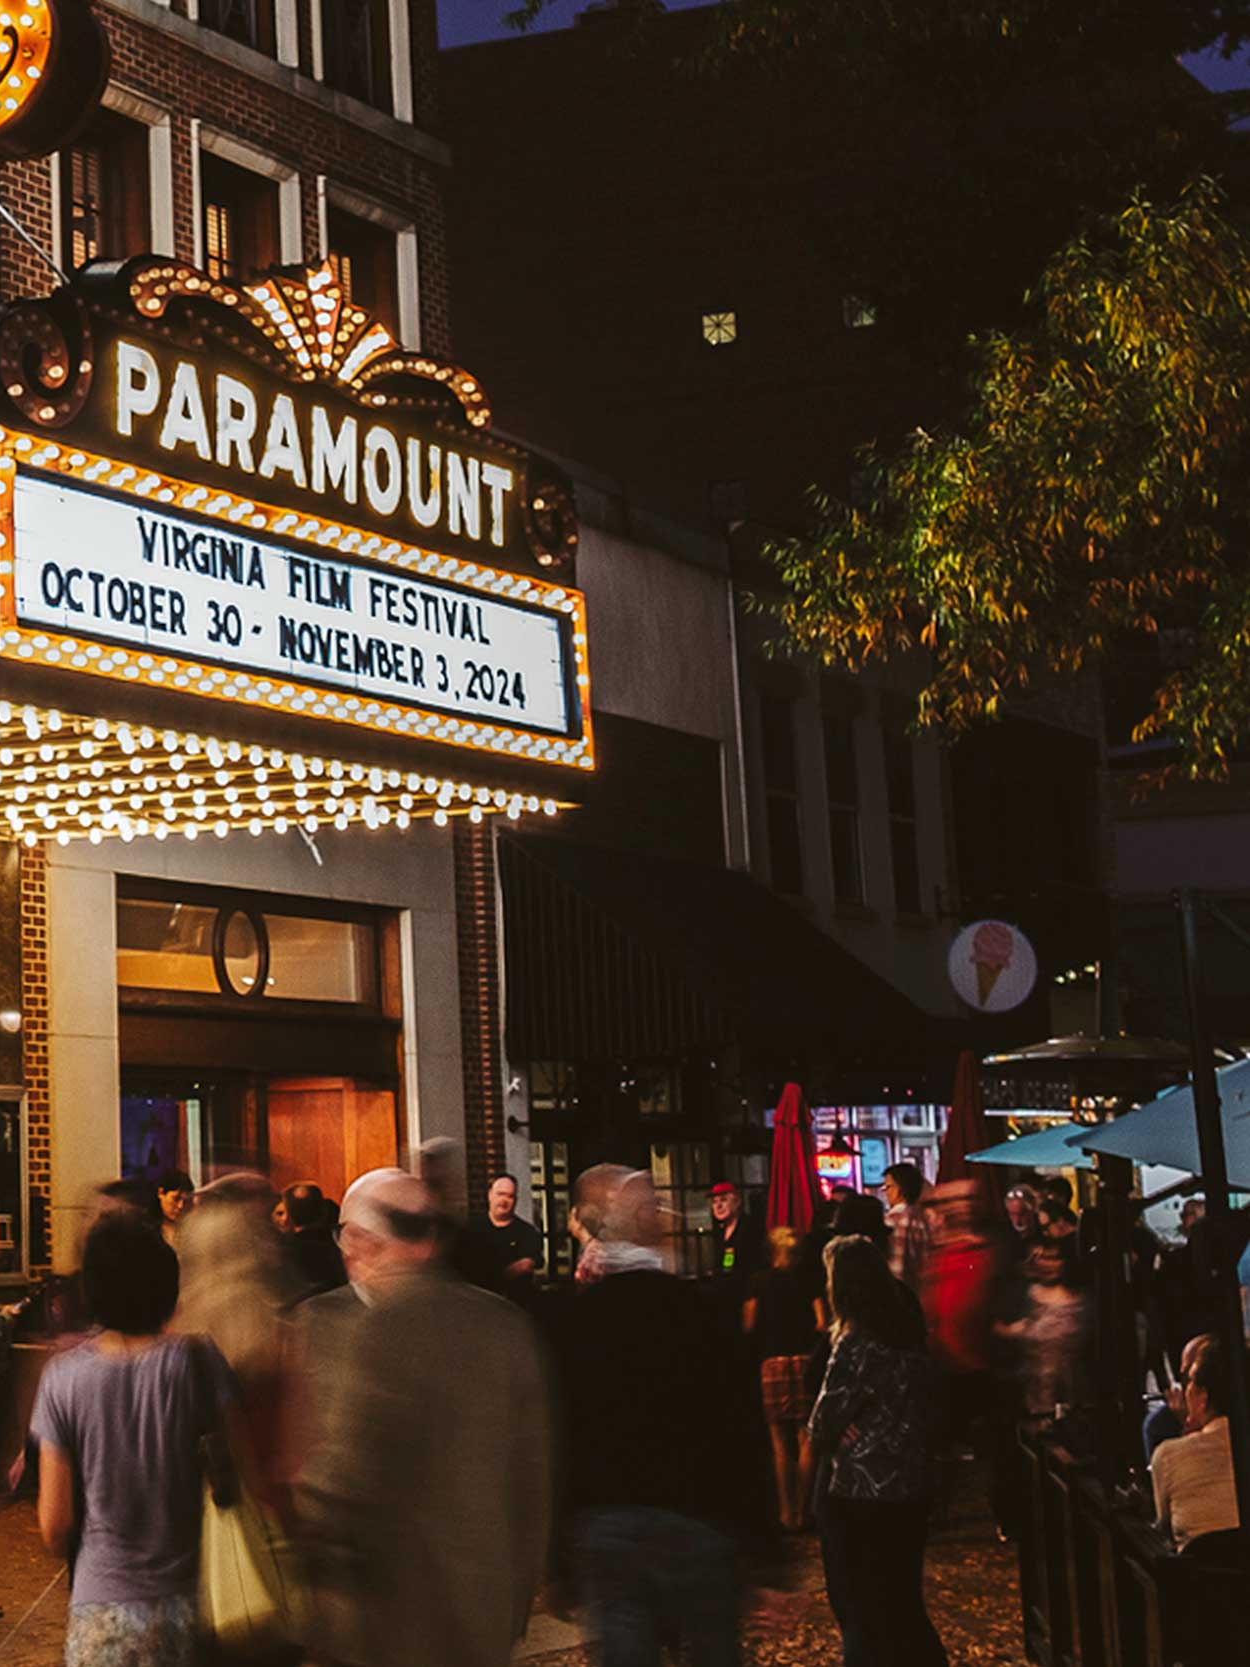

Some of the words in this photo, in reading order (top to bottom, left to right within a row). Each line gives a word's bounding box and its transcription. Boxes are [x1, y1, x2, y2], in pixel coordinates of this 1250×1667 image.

[115, 340, 513, 546] PARAMOUNT
[41, 561, 187, 636] OCTOBER
[207, 600, 242, 647] 30
[278, 614, 427, 688] NOVEMBER
[137, 516, 266, 590] VIRGINIA
[288, 555, 353, 613] FILM
[368, 577, 491, 645] FESTIVAL
